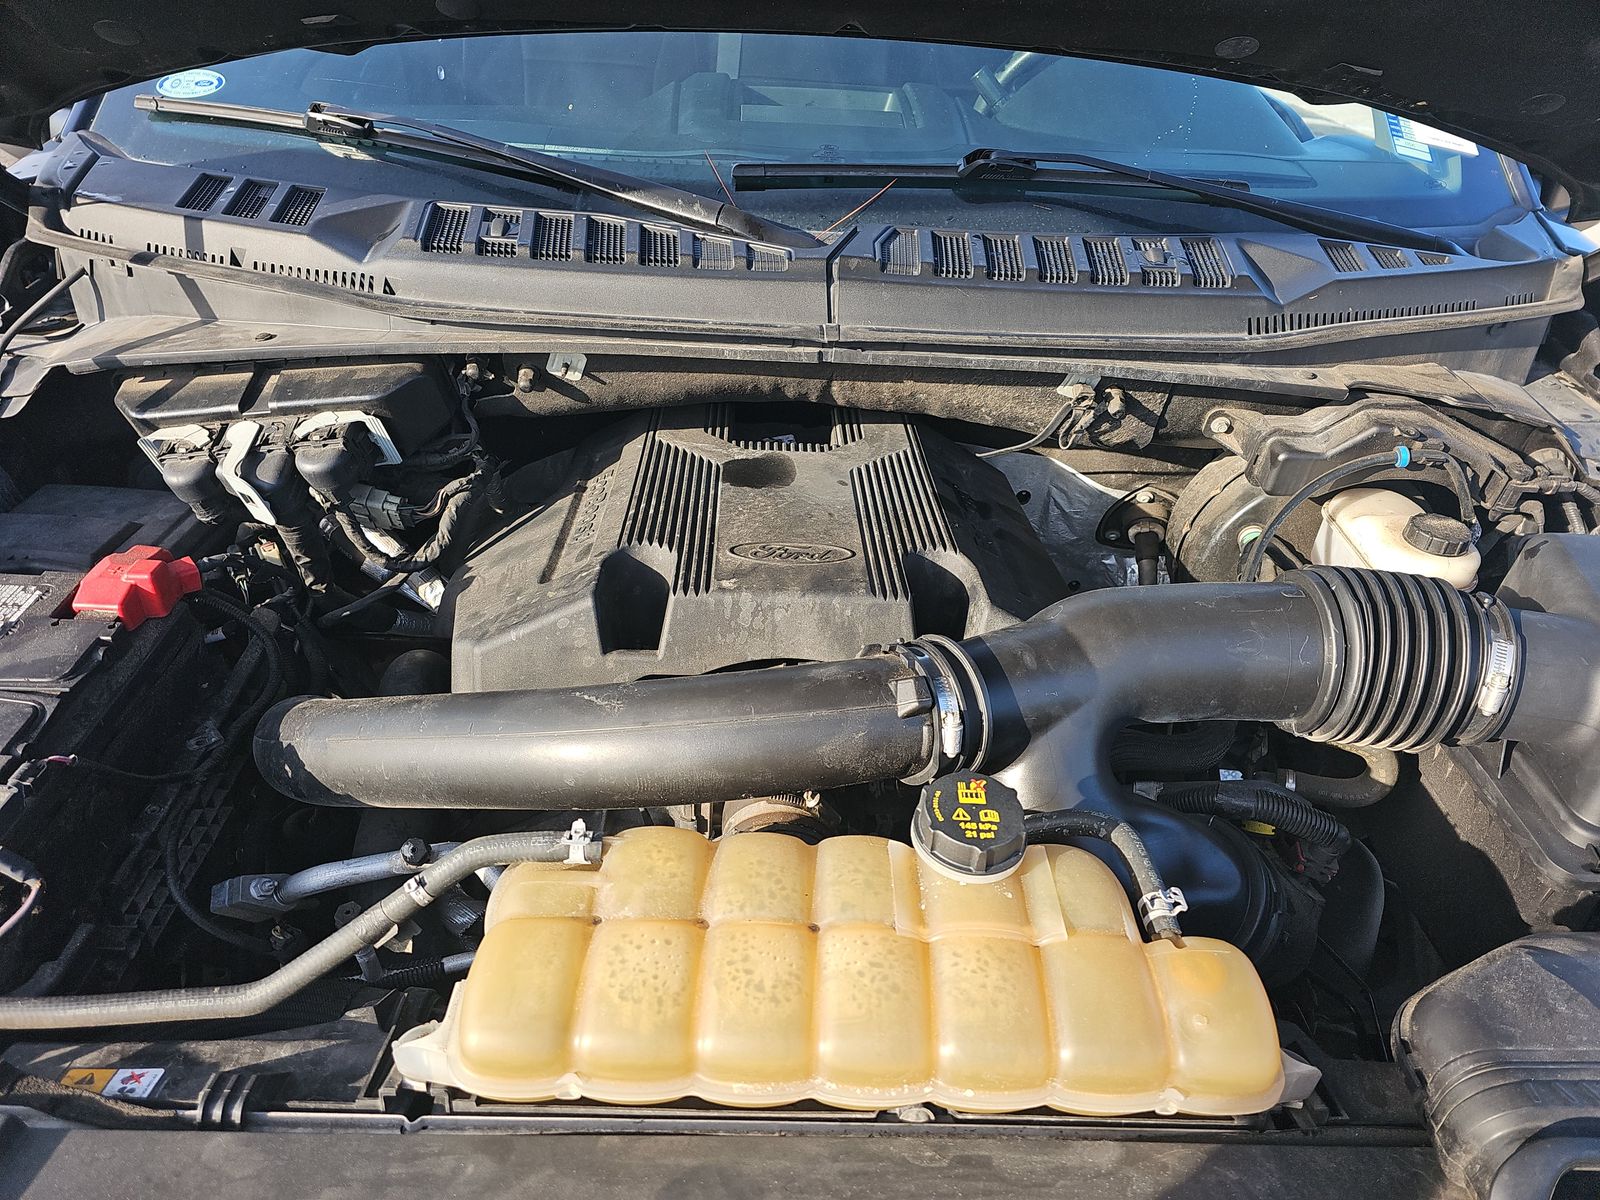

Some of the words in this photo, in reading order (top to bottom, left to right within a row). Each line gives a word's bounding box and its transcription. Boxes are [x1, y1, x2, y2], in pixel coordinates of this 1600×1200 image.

[750, 544, 833, 561] Ford
[978, 822, 998, 831] kPa
[965, 830, 978, 838] 21
[979, 831, 995, 839] psi
